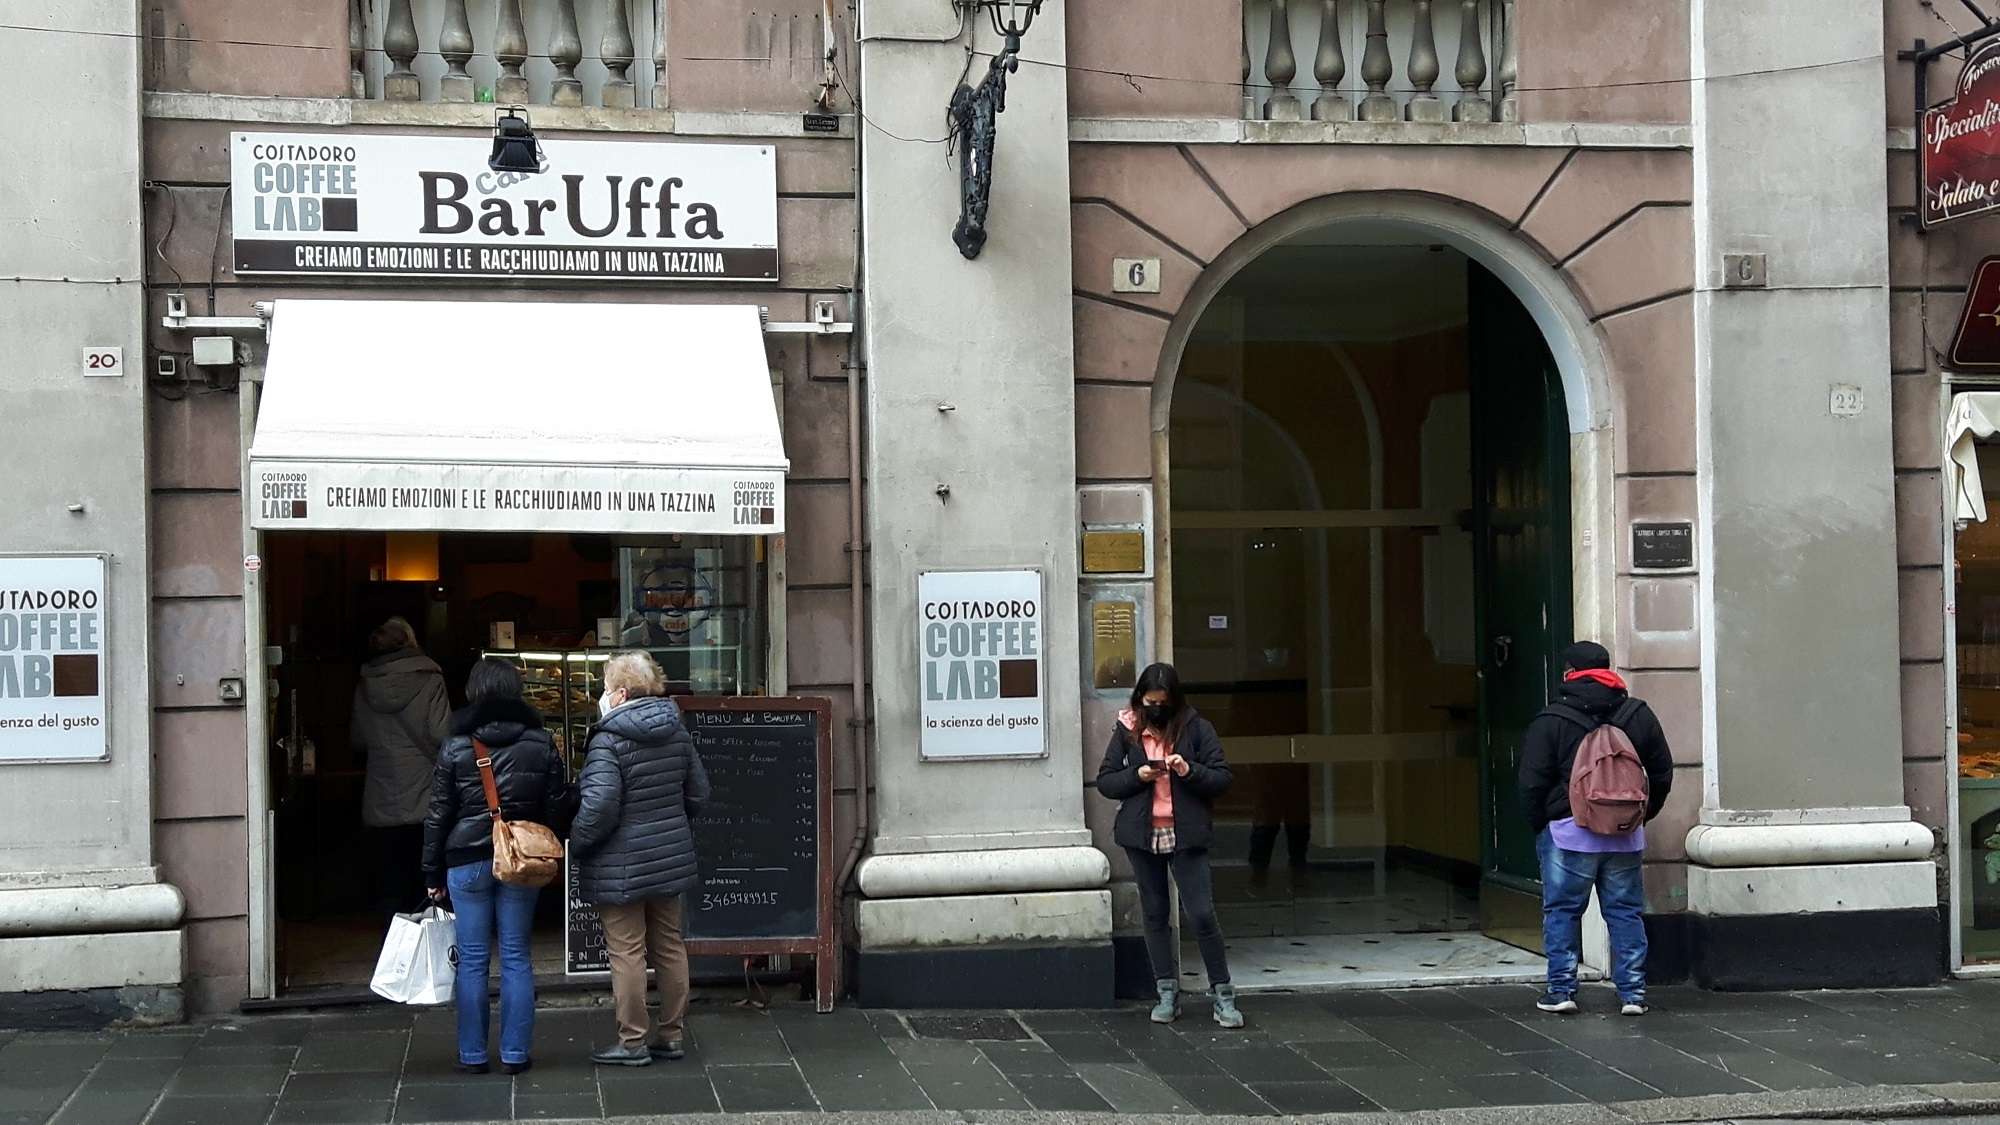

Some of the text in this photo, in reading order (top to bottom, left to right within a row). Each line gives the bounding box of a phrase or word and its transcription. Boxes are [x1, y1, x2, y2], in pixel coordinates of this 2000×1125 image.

[253, 145, 356, 162] COSTADORO
[254, 162, 357, 194] COFFEE
[1931, 178, 1999, 211] Salato e
[254, 196, 321, 232] LAB
[295, 246, 725, 273] CREIAMO EMOZIONI E LE RACCHIUDIAMO IN UNA TAZZINA
[1129, 263, 1144, 286] 6
[89, 354, 115, 368] 20
[1836, 394, 1856, 409] 22
[262, 473, 307, 482] COSTADORO
[733, 481, 775, 490] COSTADORO
[262, 483, 307, 499] COFFEE
[327, 487, 716, 513] CREIAMO EMOZIONI E LE RACCHIUDIAMO IN UNA TAZZINA
[733, 491, 775, 507] COFFEE
[262, 500, 291, 519] LAB
[733, 507, 760, 525] LAB
[925, 600, 1036, 620] COSTADORO
[0, 613, 98, 652] OFFEE
[926, 621, 1037, 657] COFFEE
[926, 660, 998, 701] LAB
[38, 713, 58, 728] del
[63, 715, 99, 730] gusto
[926, 714, 1039, 729] la scienza del gusto
